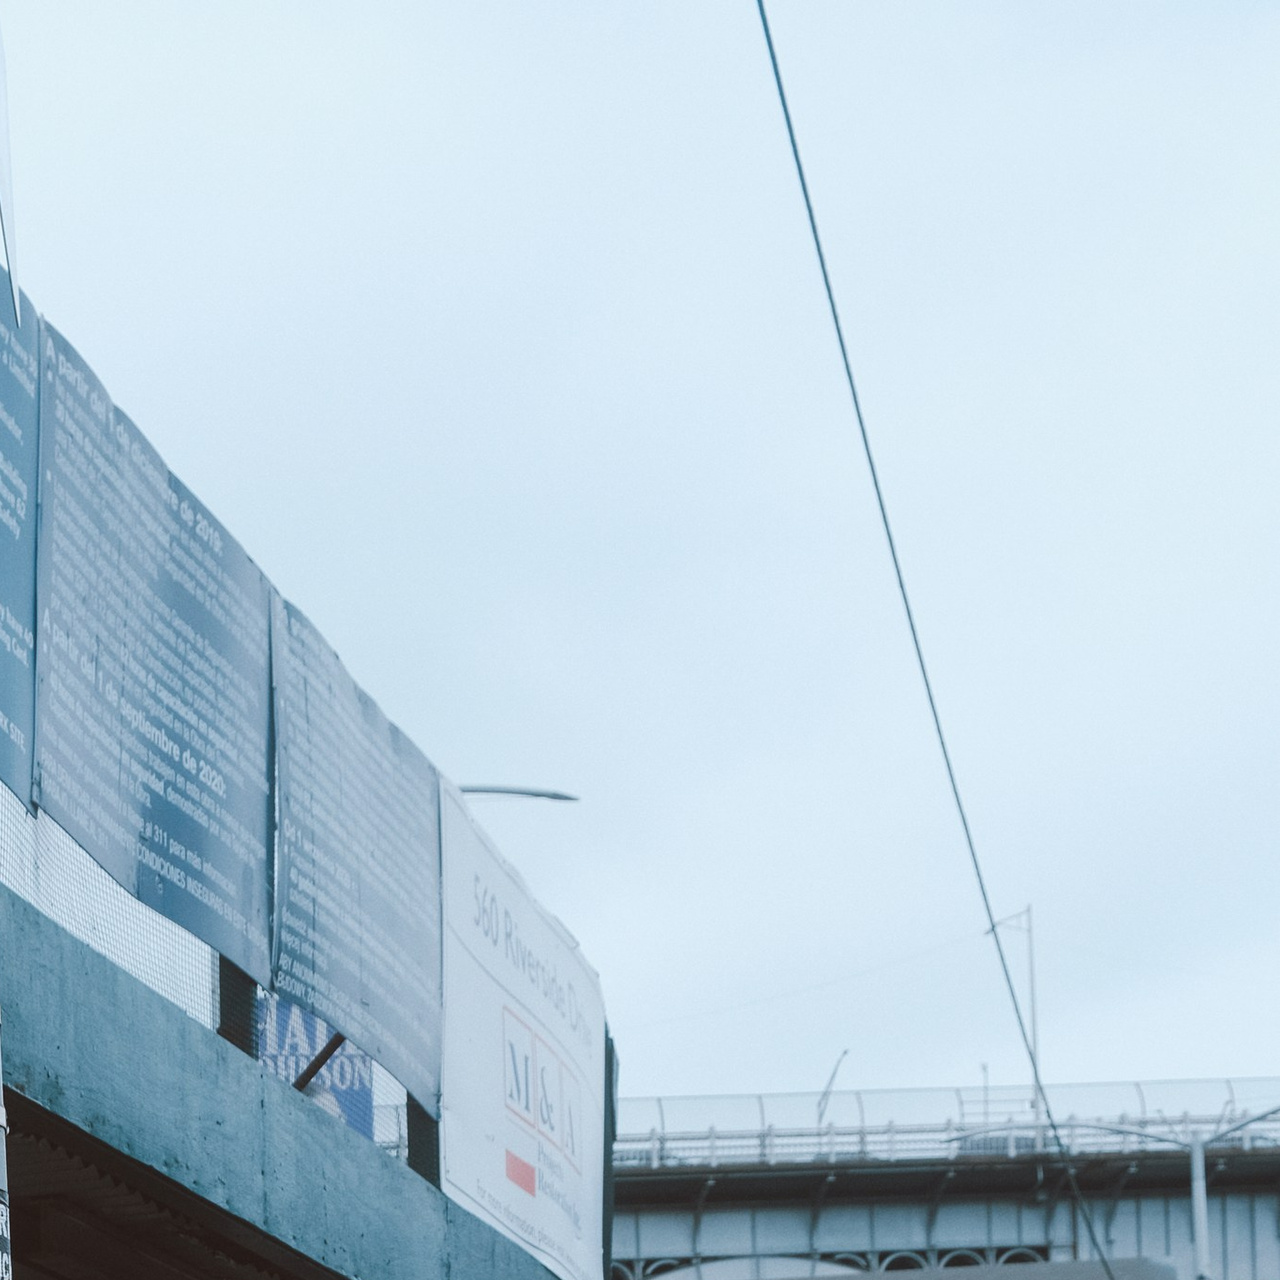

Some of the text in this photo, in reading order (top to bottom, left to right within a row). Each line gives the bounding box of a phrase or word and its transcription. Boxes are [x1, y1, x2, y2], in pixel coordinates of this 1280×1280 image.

[46, 336, 56, 363] A
[182, 748, 197, 775] de
[154, 821, 168, 847] 311
